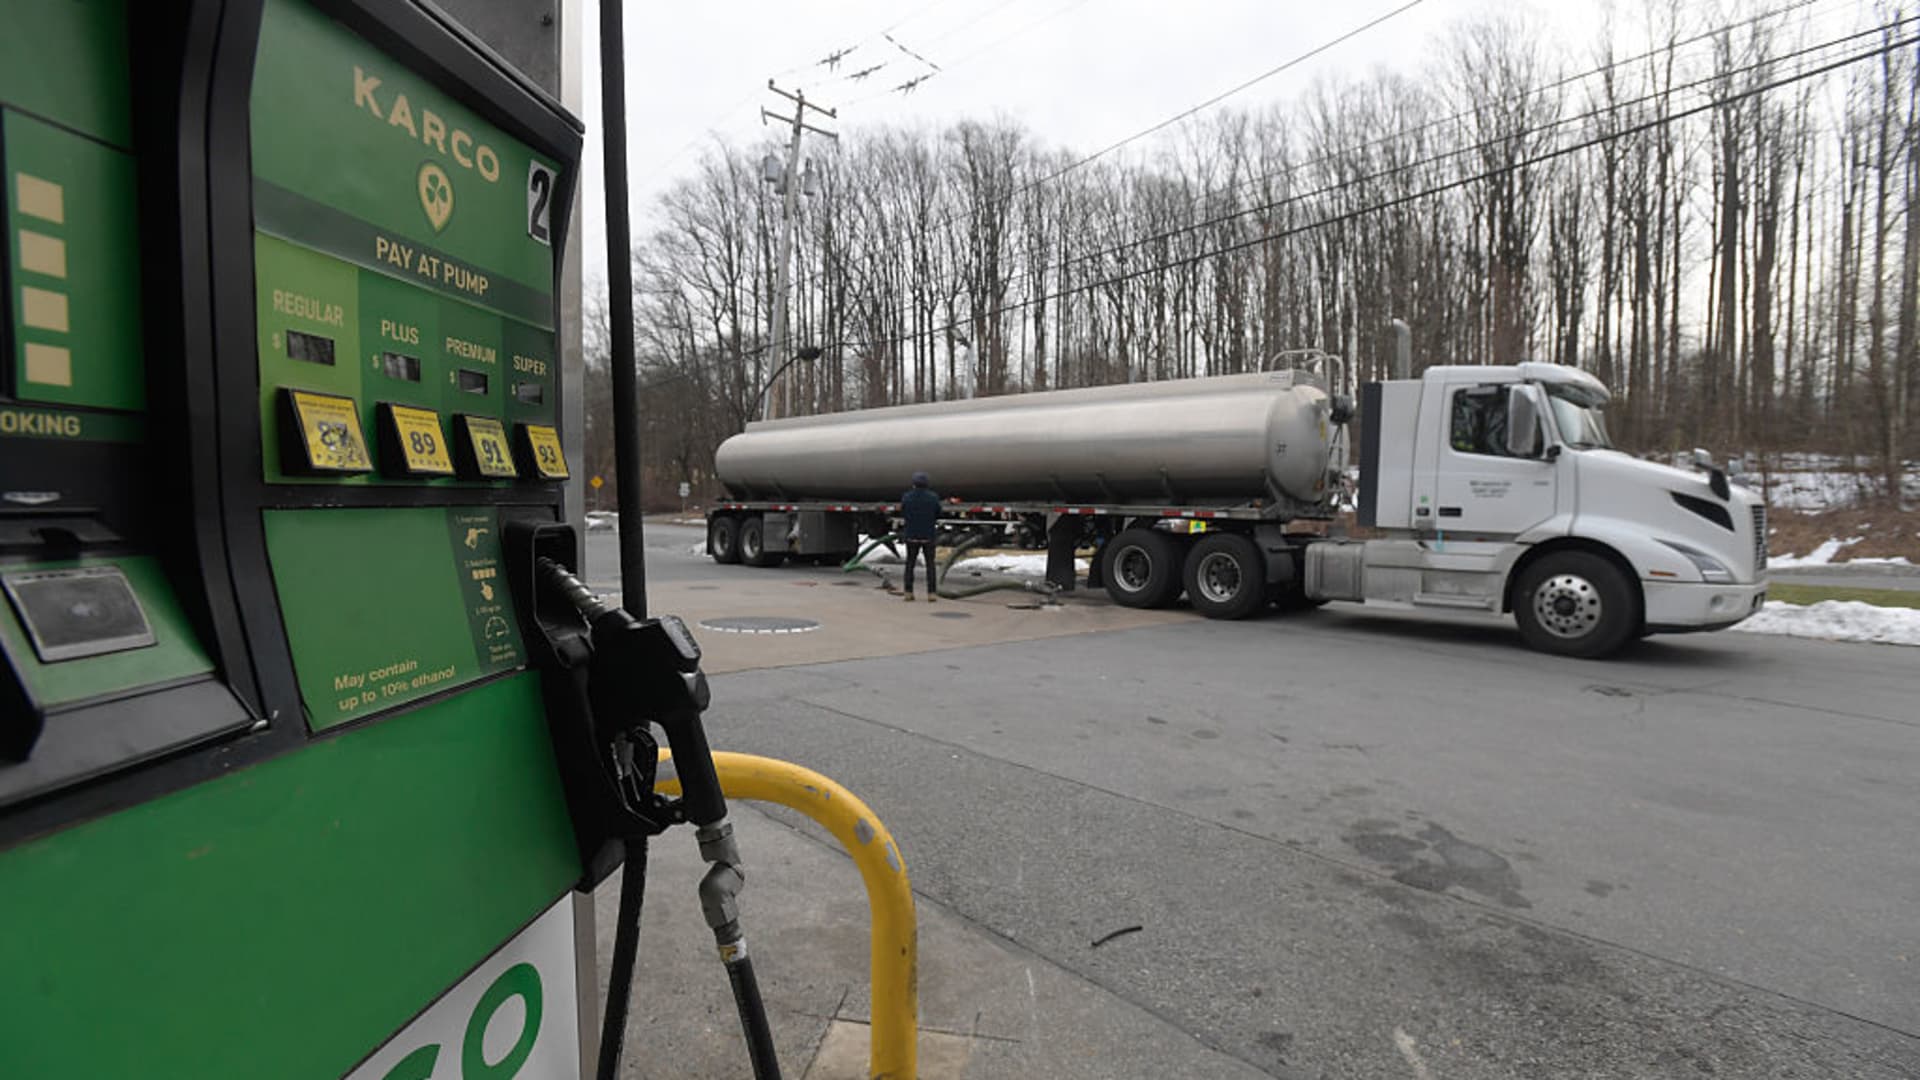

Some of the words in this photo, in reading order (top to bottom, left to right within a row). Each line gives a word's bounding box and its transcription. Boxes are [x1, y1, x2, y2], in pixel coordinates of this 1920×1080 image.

[354, 66, 499, 182] KARCO
[530, 168, 551, 239] 2
[376, 236, 413, 269] PAY
[418, 252, 439, 280] AT
[444, 264, 489, 296] PUMP
[273, 289, 344, 327] REGULAR
[381, 319, 420, 345] PLUS
[446, 336, 497, 365] PREMIUM
[513, 354, 547, 377] SUPER
[410, 430, 436, 455] 89
[481, 438, 505, 464] 91
[538, 444, 557, 464] 93
[335, 673, 365, 692] May
[369, 660, 418, 681] contain
[339, 696, 359, 711] up
[362, 691, 377, 703] to
[382, 682, 409, 697] 10%
[412, 665, 456, 689] ethanol
